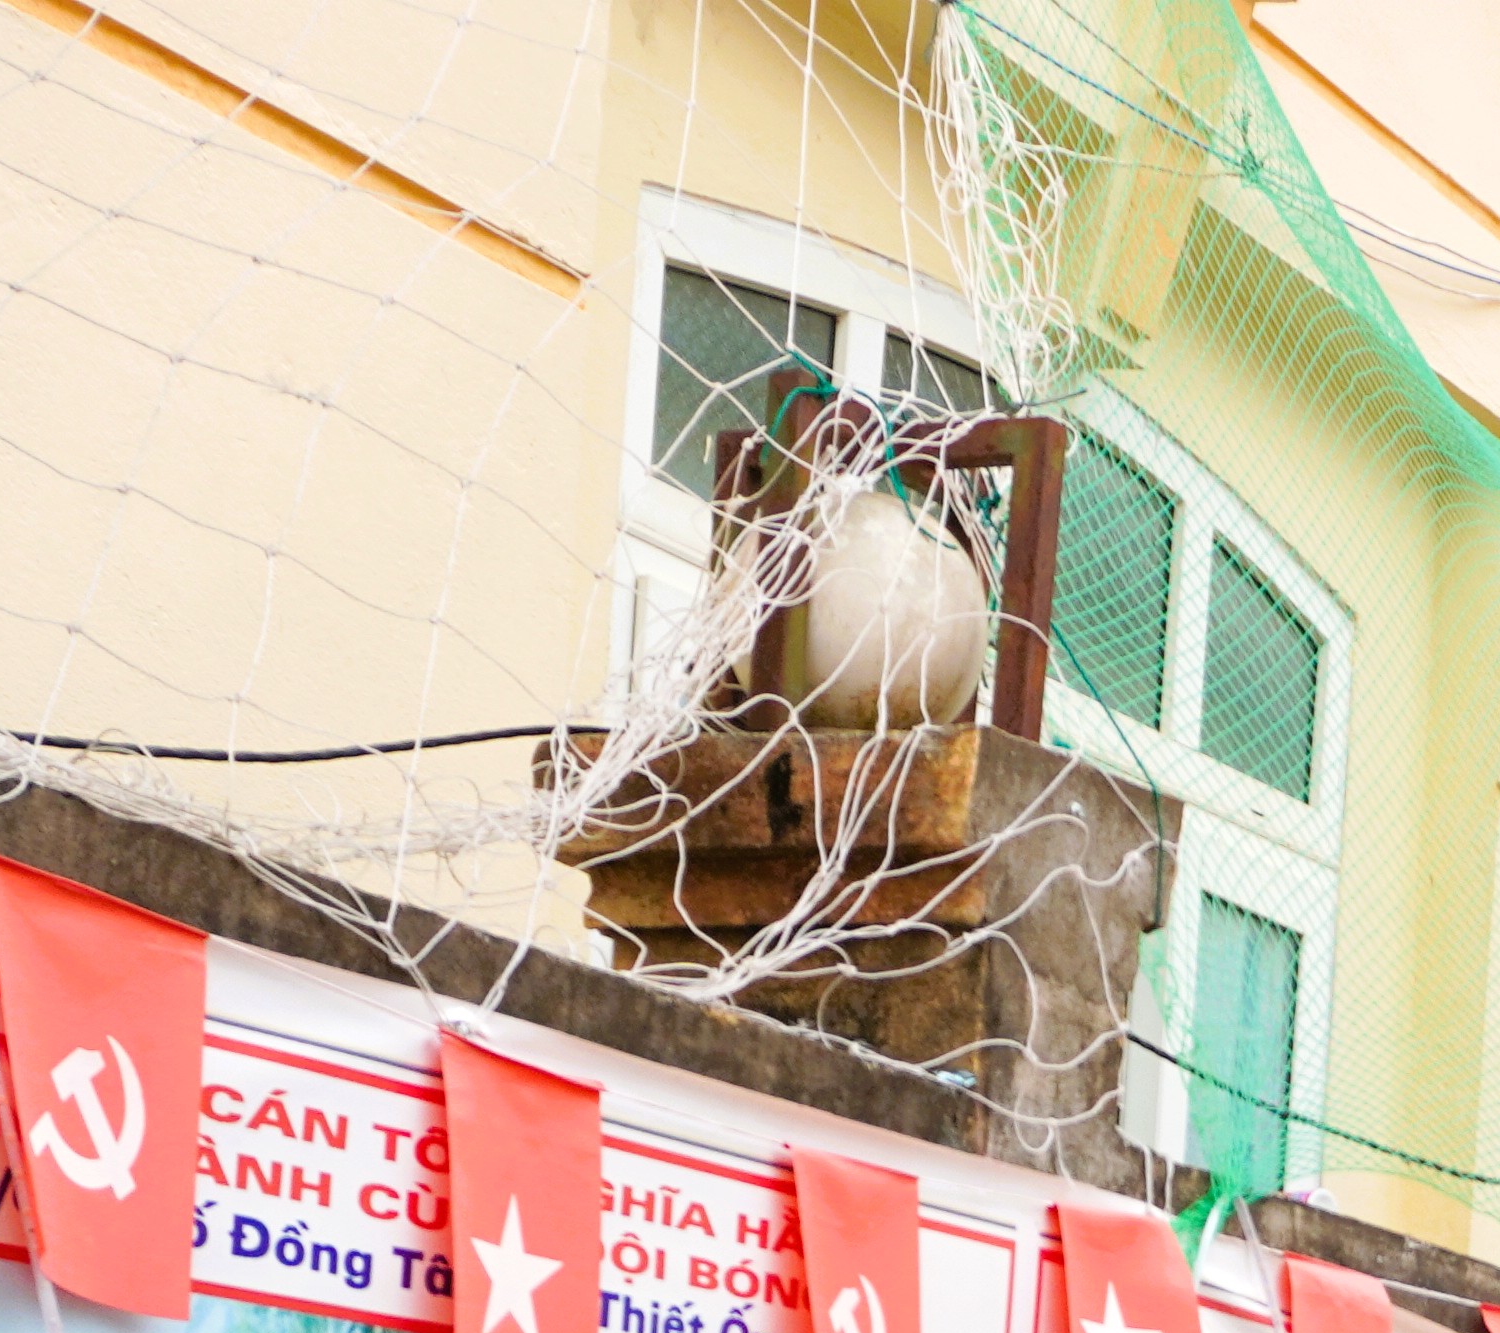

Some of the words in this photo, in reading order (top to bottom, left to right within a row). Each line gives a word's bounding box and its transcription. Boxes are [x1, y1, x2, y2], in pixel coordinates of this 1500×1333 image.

[199, 1084, 348, 1150] CÁN
[372, 1122, 450, 1174] TÔ
[196, 1135, 331, 1207] ÀNH
[358, 1183, 450, 1231] CÙ
[600, 1232, 665, 1284] ỘI
[688, 1259, 811, 1312] BÓN
[229, 1213, 373, 1290] Đồng
[392, 1246, 453, 1298] Tâ
